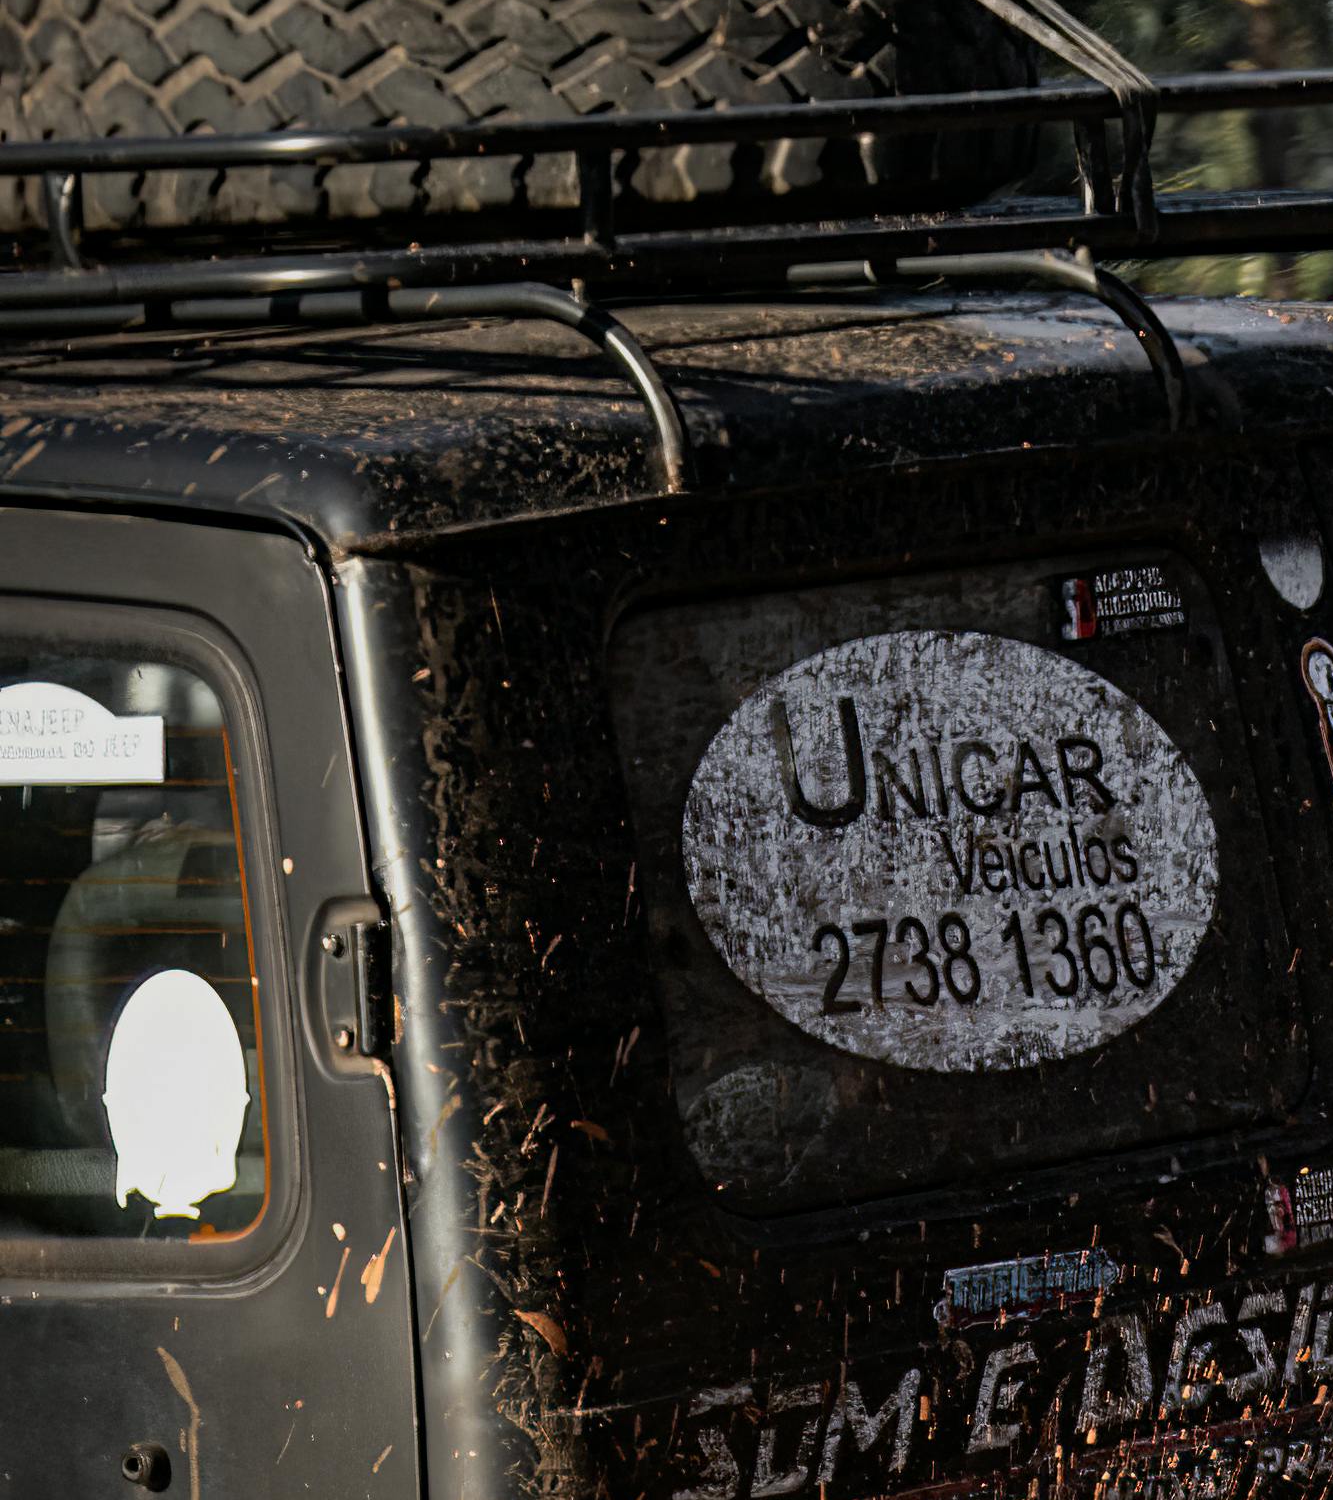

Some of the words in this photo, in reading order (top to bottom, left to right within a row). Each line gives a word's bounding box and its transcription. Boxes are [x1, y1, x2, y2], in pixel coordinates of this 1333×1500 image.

[813, 910, 981, 1016] 2738
[1001, 901, 1155, 998] 1360
[963, 1339, 1042, 1456] E
